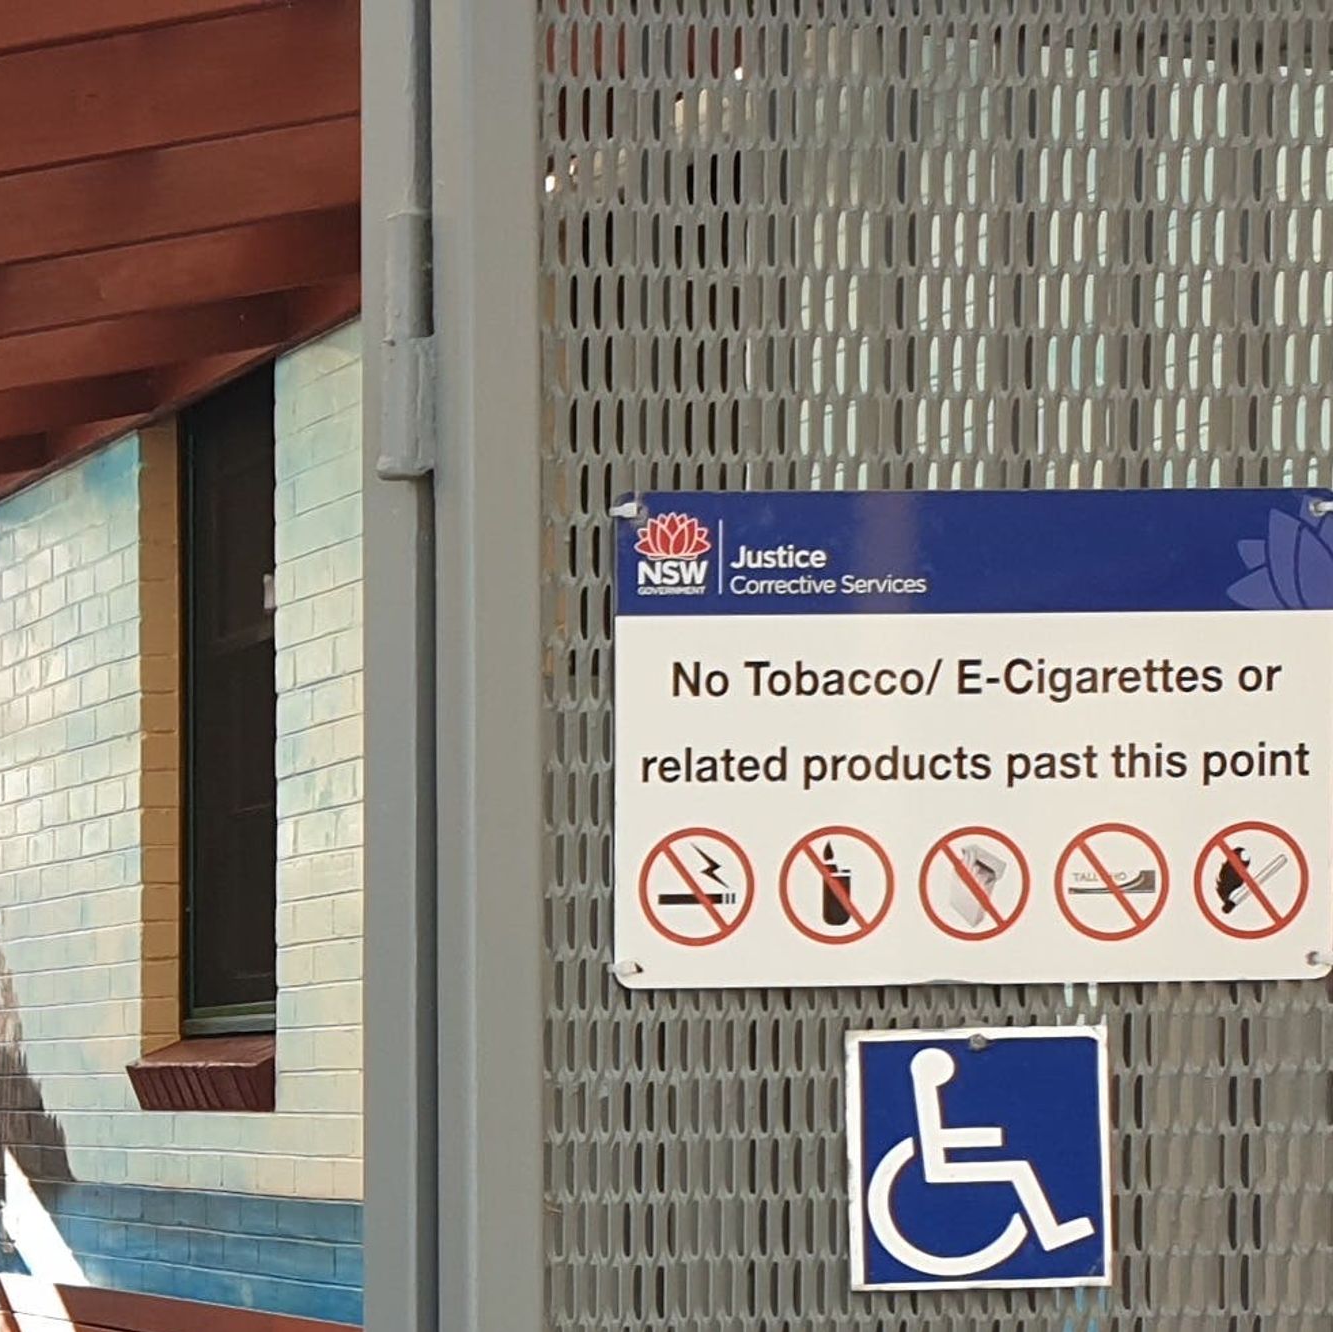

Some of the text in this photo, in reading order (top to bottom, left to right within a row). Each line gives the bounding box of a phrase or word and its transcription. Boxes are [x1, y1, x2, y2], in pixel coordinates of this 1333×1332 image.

[730, 545, 826, 569] Justice
[637, 560, 708, 585] NSW
[730, 574, 927, 595] Corrective Services
[637, 586, 706, 595] GOVERNMENT
[671, 657, 1283, 703] No Tobacco/ E-Cigarettes or
[641, 741, 1310, 789] related products past this point
